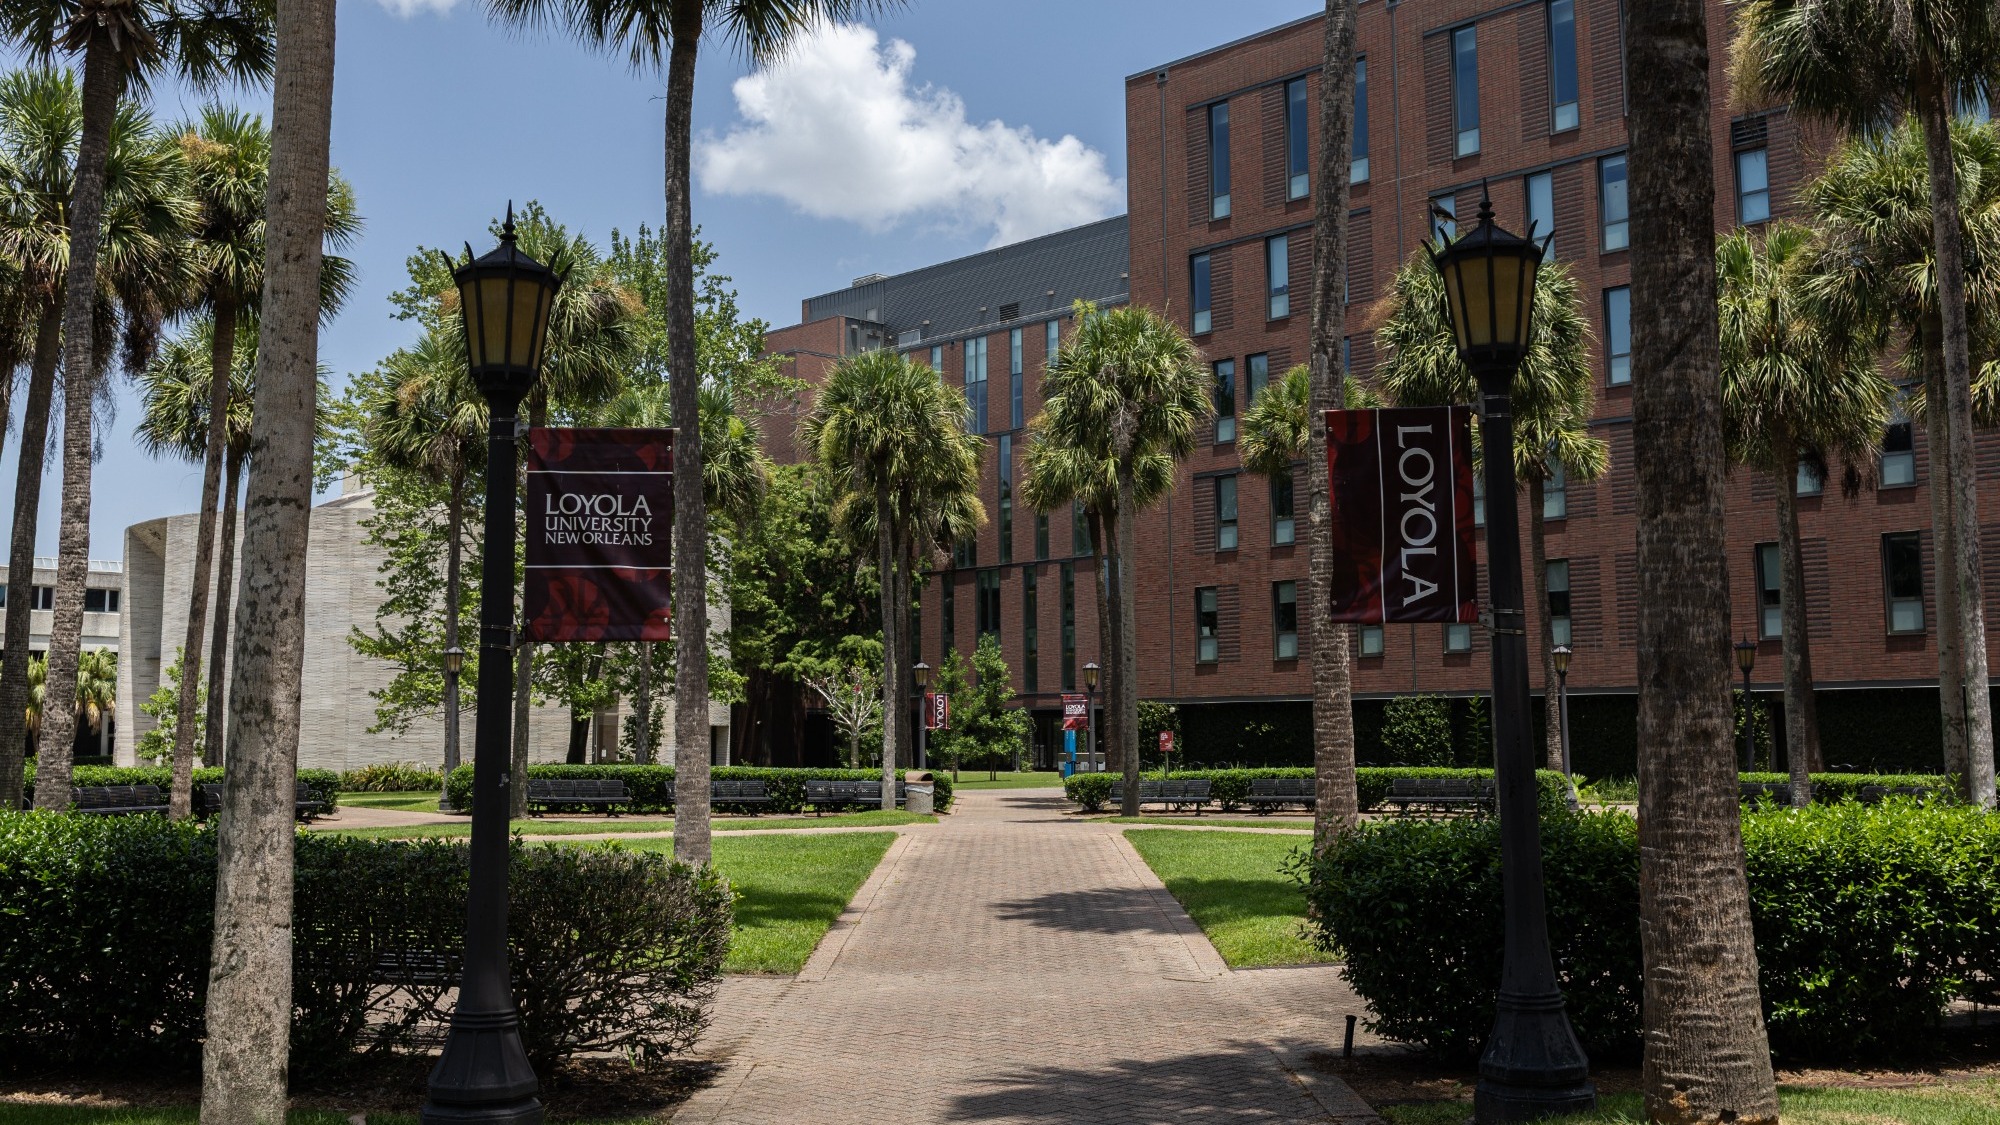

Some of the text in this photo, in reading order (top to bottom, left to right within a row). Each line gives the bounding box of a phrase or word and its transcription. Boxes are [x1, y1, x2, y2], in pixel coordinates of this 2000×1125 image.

[545, 493, 652, 516] LOYOLA
[545, 516, 653, 532] UNIVERSITY
[1397, 425, 1438, 608] LOYOLA
[545, 531, 653, 546] NEW ORLEANS
[936, 695, 944, 728] LOYOLA
